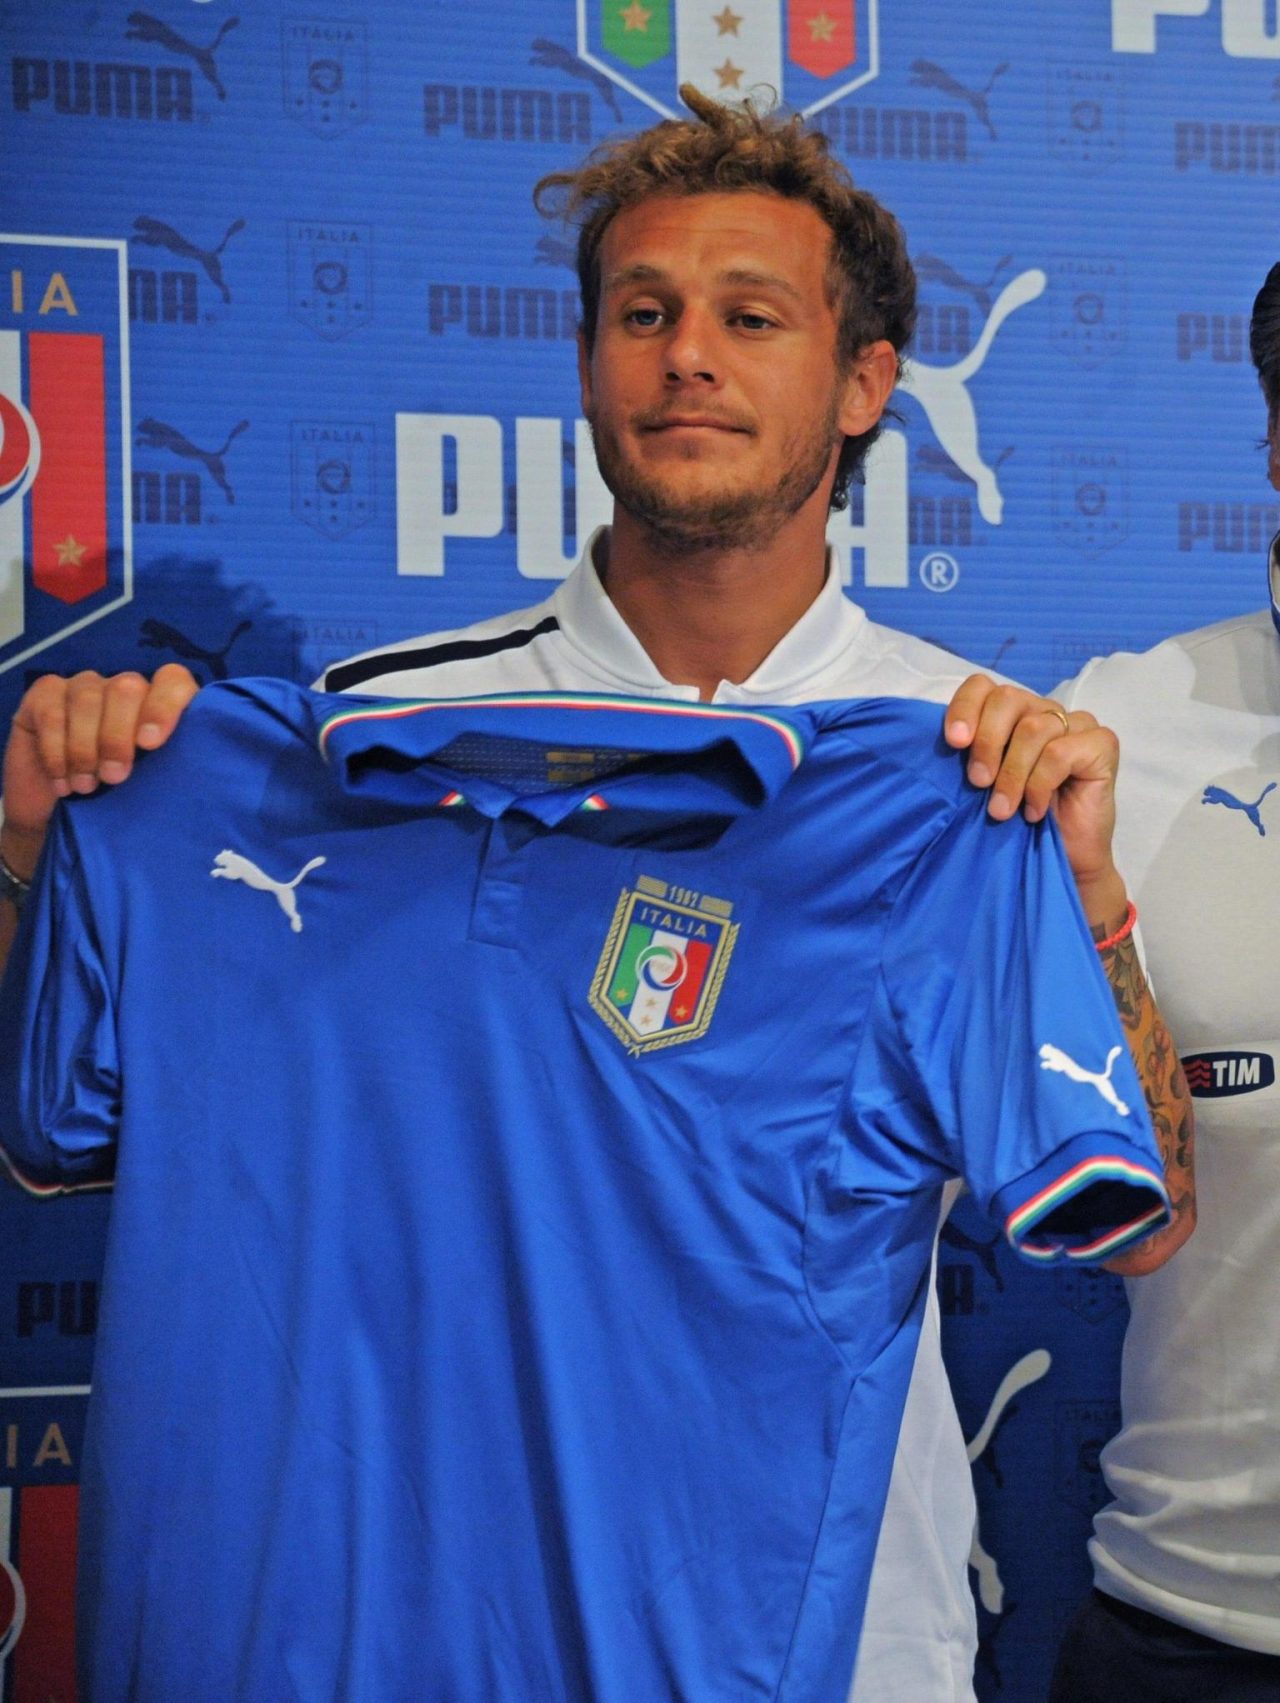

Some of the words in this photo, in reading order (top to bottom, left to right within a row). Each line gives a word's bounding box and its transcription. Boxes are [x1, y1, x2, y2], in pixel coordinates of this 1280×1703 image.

[11, 57, 193, 121] PUMA
[423, 83, 592, 144] PUMA
[301, 428, 365, 444] ITALIA
[640, 908, 707, 938] ITALIA
[1212, 1058, 1260, 1087] TIM
